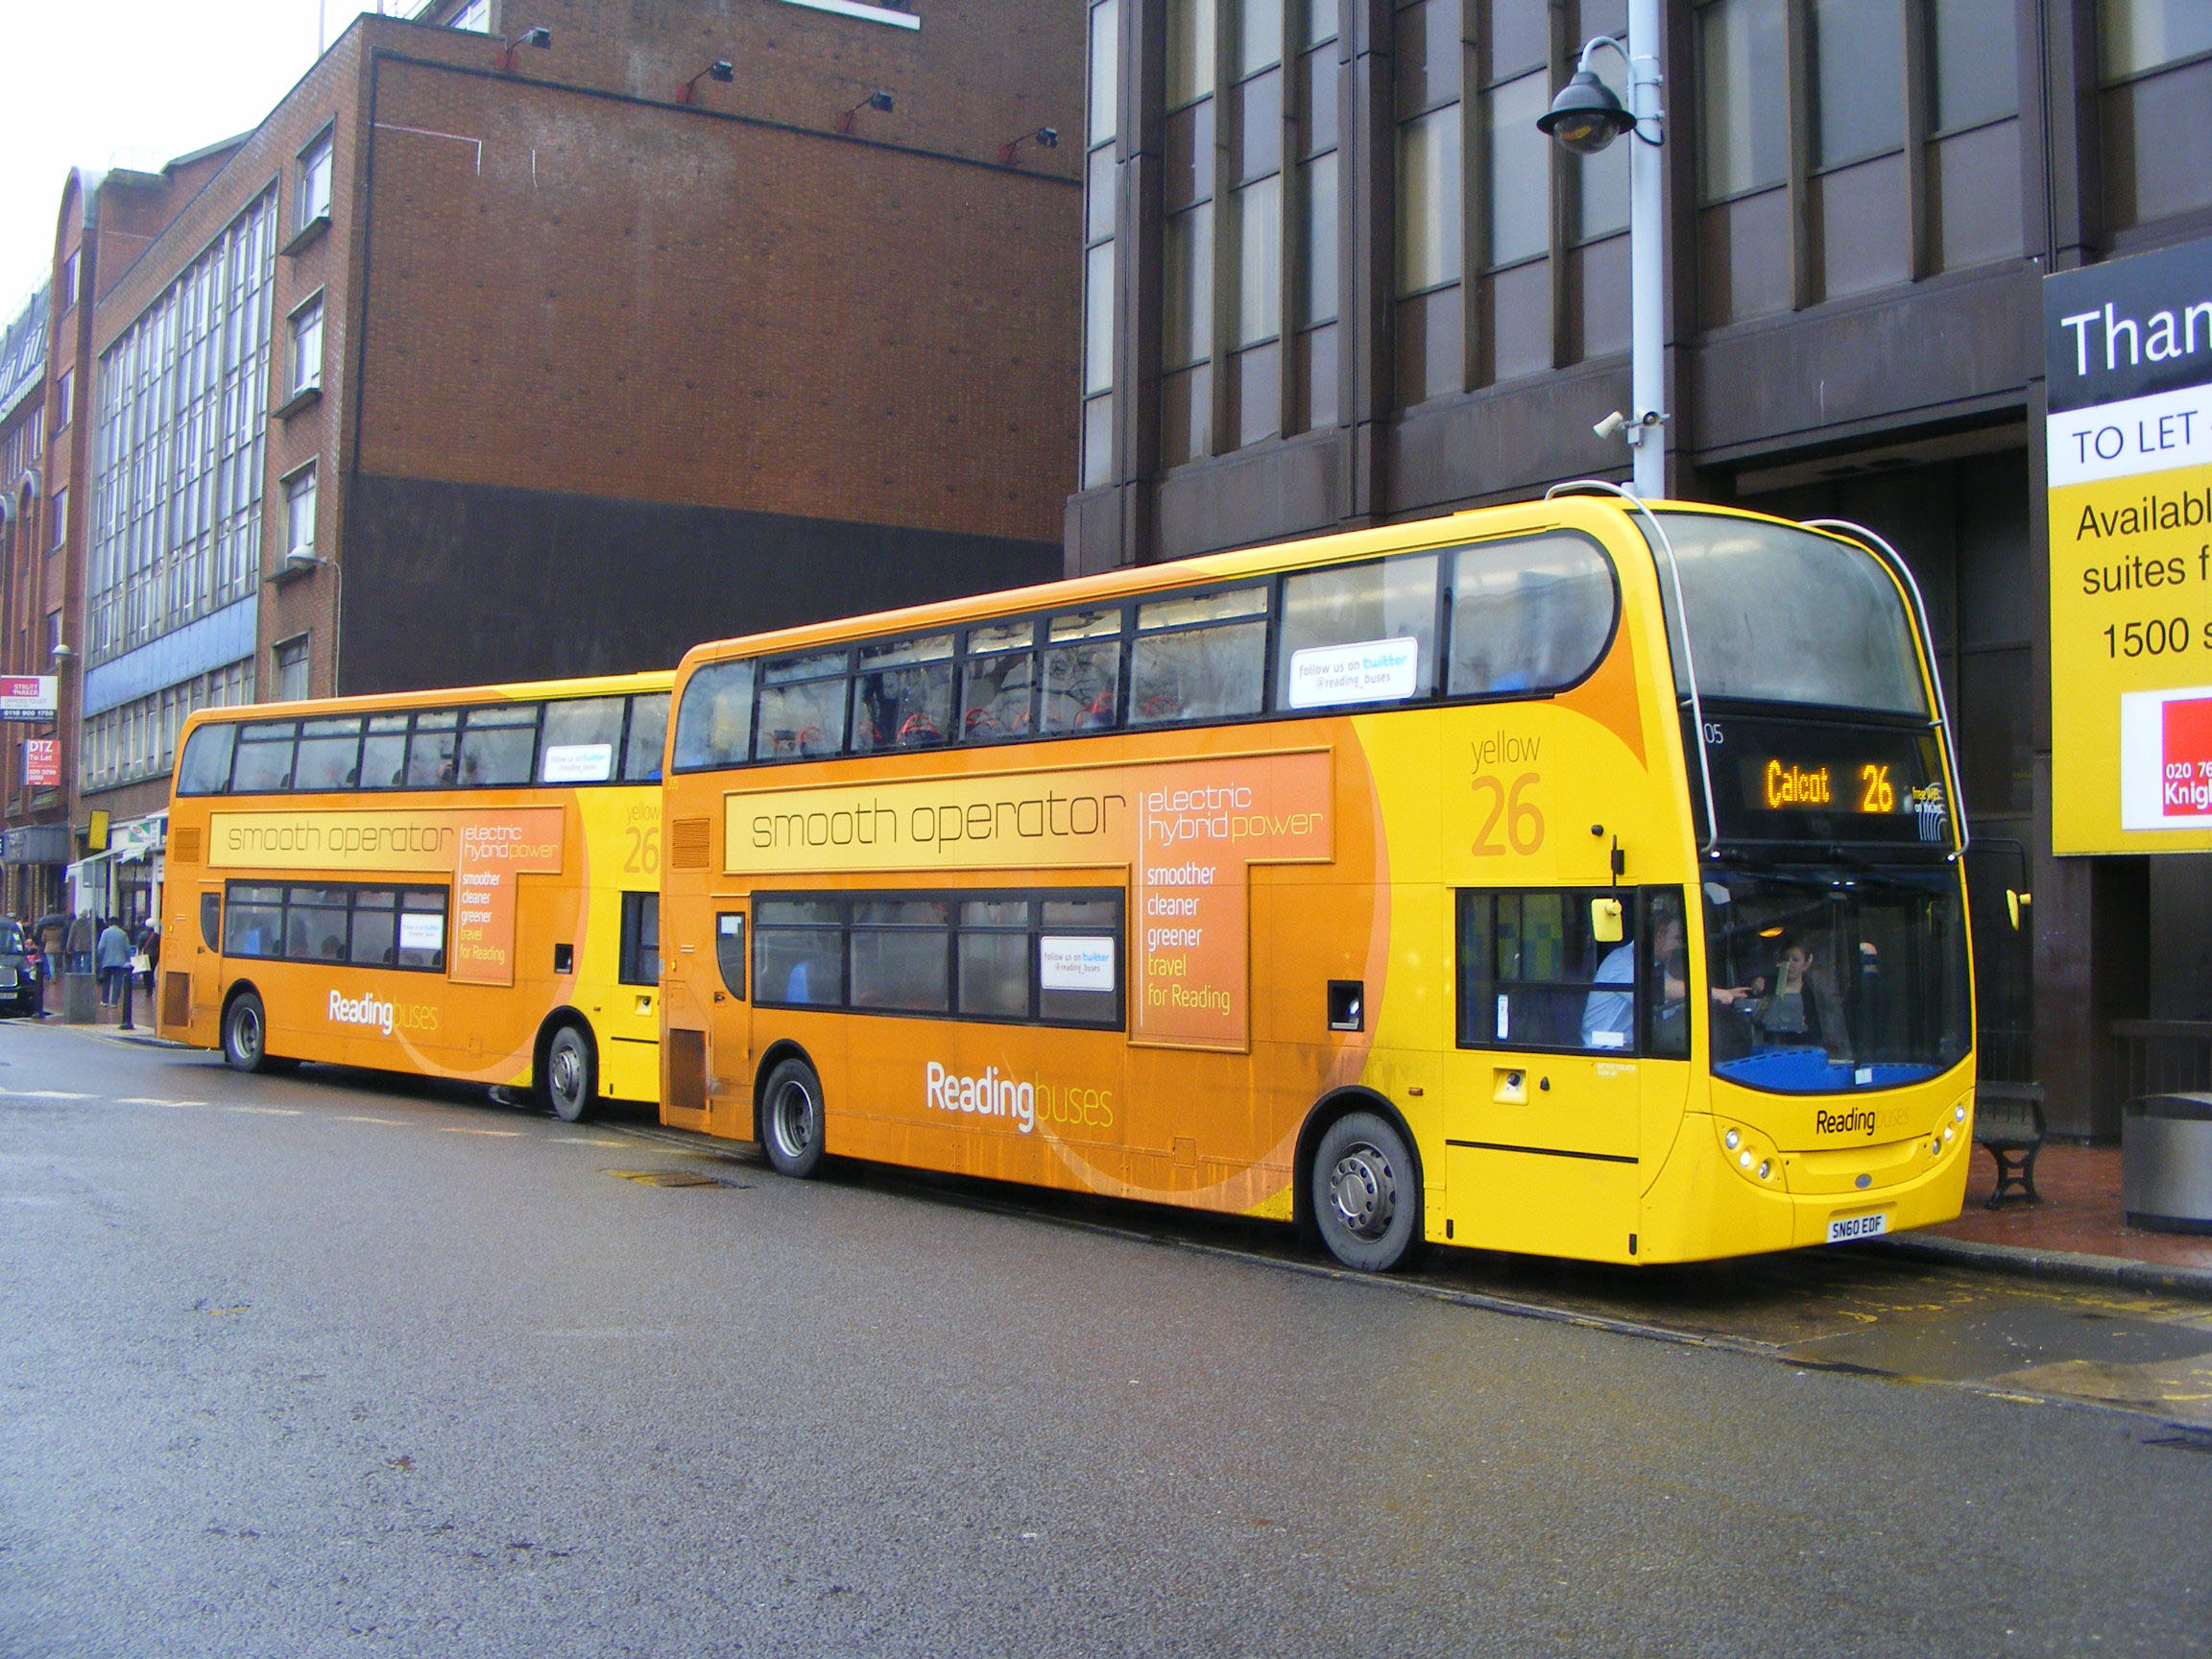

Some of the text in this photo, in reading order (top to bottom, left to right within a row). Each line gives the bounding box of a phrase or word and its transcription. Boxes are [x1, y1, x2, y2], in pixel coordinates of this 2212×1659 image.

[2072, 410, 2198, 464] TO LET
[2076, 488, 2212, 541] Availabl
[2083, 554, 2186, 595] suites
[2104, 616, 2190, 659] 1500
[1299, 654, 1409, 678] follow us on twitter
[30, 740, 53, 753] DTZ
[1471, 730, 1541, 775] yellow
[1767, 759, 1893, 812] Calcot 26
[2165, 762, 2192, 780] 020
[1147, 781, 1252, 812] electric
[626, 800, 661, 826] yellow
[752, 790, 1126, 854] smooth operator
[1471, 772, 1545, 856] 26
[228, 820, 454, 859] smooth operator
[465, 825, 522, 841] electric
[1147, 811, 1324, 847] hybrid power
[623, 827, 660, 875] 26
[462, 871, 500, 886] smoother
[1146, 861, 1216, 886] smoother
[461, 910, 493, 926] greener
[1146, 892, 1200, 916] cleaner
[1146, 927, 1203, 952] greener
[472, 946, 505, 966] Reading
[1146, 953, 1187, 976] travel
[328, 989, 394, 1036] Reading
[1146, 982, 1231, 1016] for Reading
[926, 1061, 1114, 1134] Reading buses
[1816, 1107, 1875, 1136] Reading
[1832, 1215, 1882, 1238] SN60 EDF
